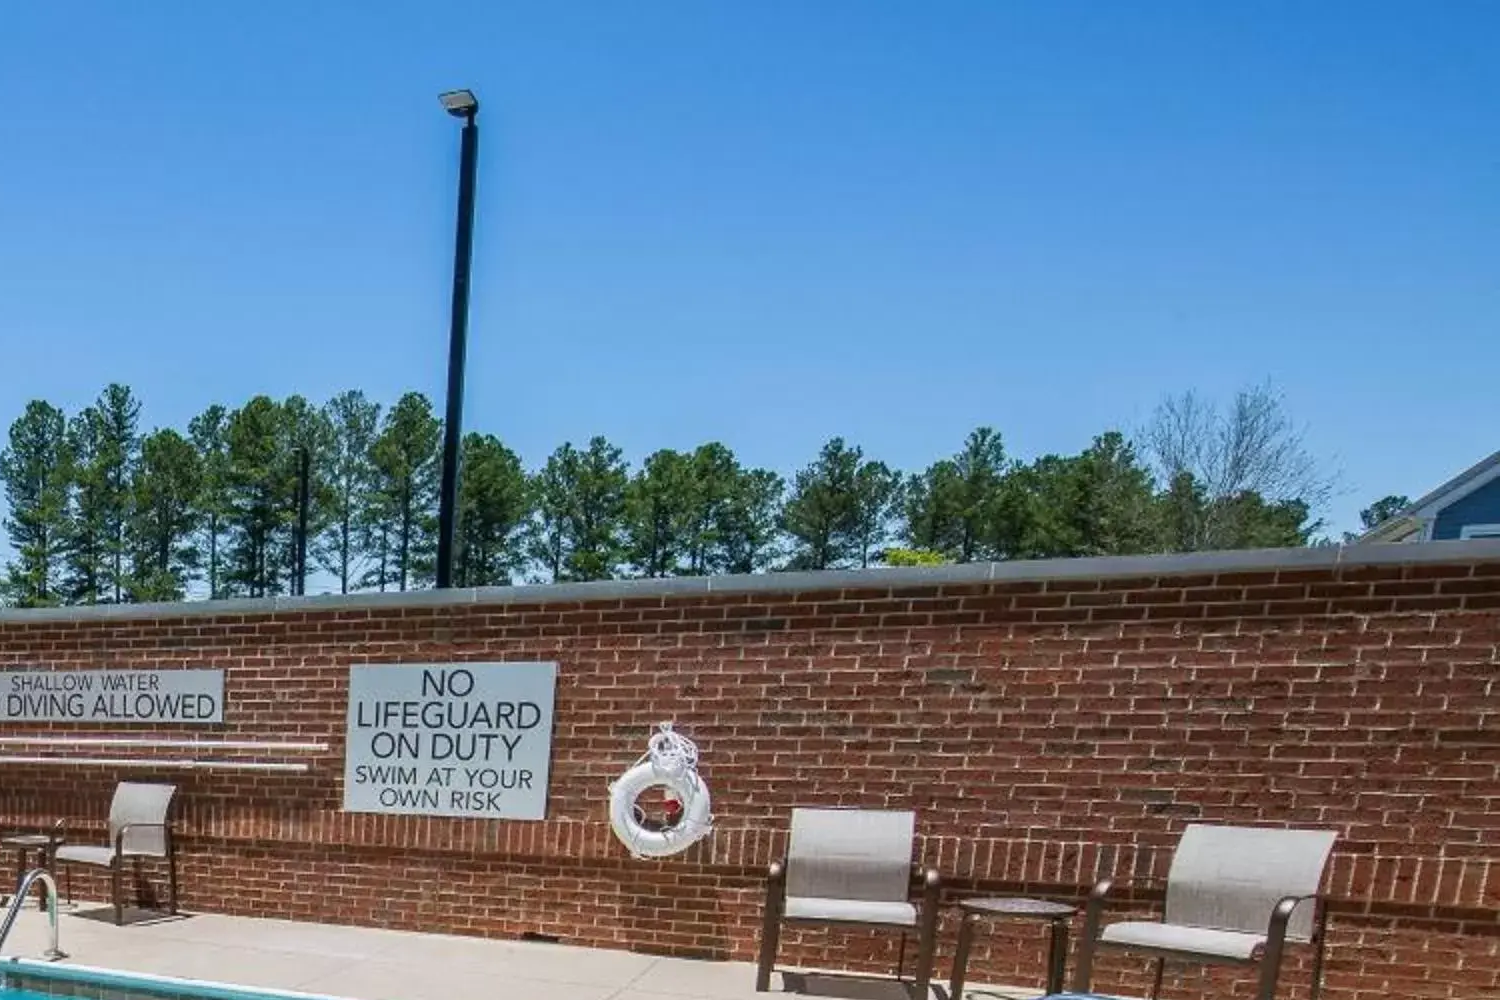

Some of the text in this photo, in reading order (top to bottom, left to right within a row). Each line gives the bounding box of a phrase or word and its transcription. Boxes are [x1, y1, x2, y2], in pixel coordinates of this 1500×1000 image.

[11, 673, 160, 693] SHALLOW WATER
[421, 669, 475, 698] NO
[7, 694, 84, 718] DIVING
[91, 694, 215, 719] ALLOWED
[357, 701, 541, 730] LIFEGUARD
[371, 731, 522, 762] ON DUTY
[355, 765, 534, 790] SWIM AT YOUR
[379, 787, 502, 812] OWN RISK
